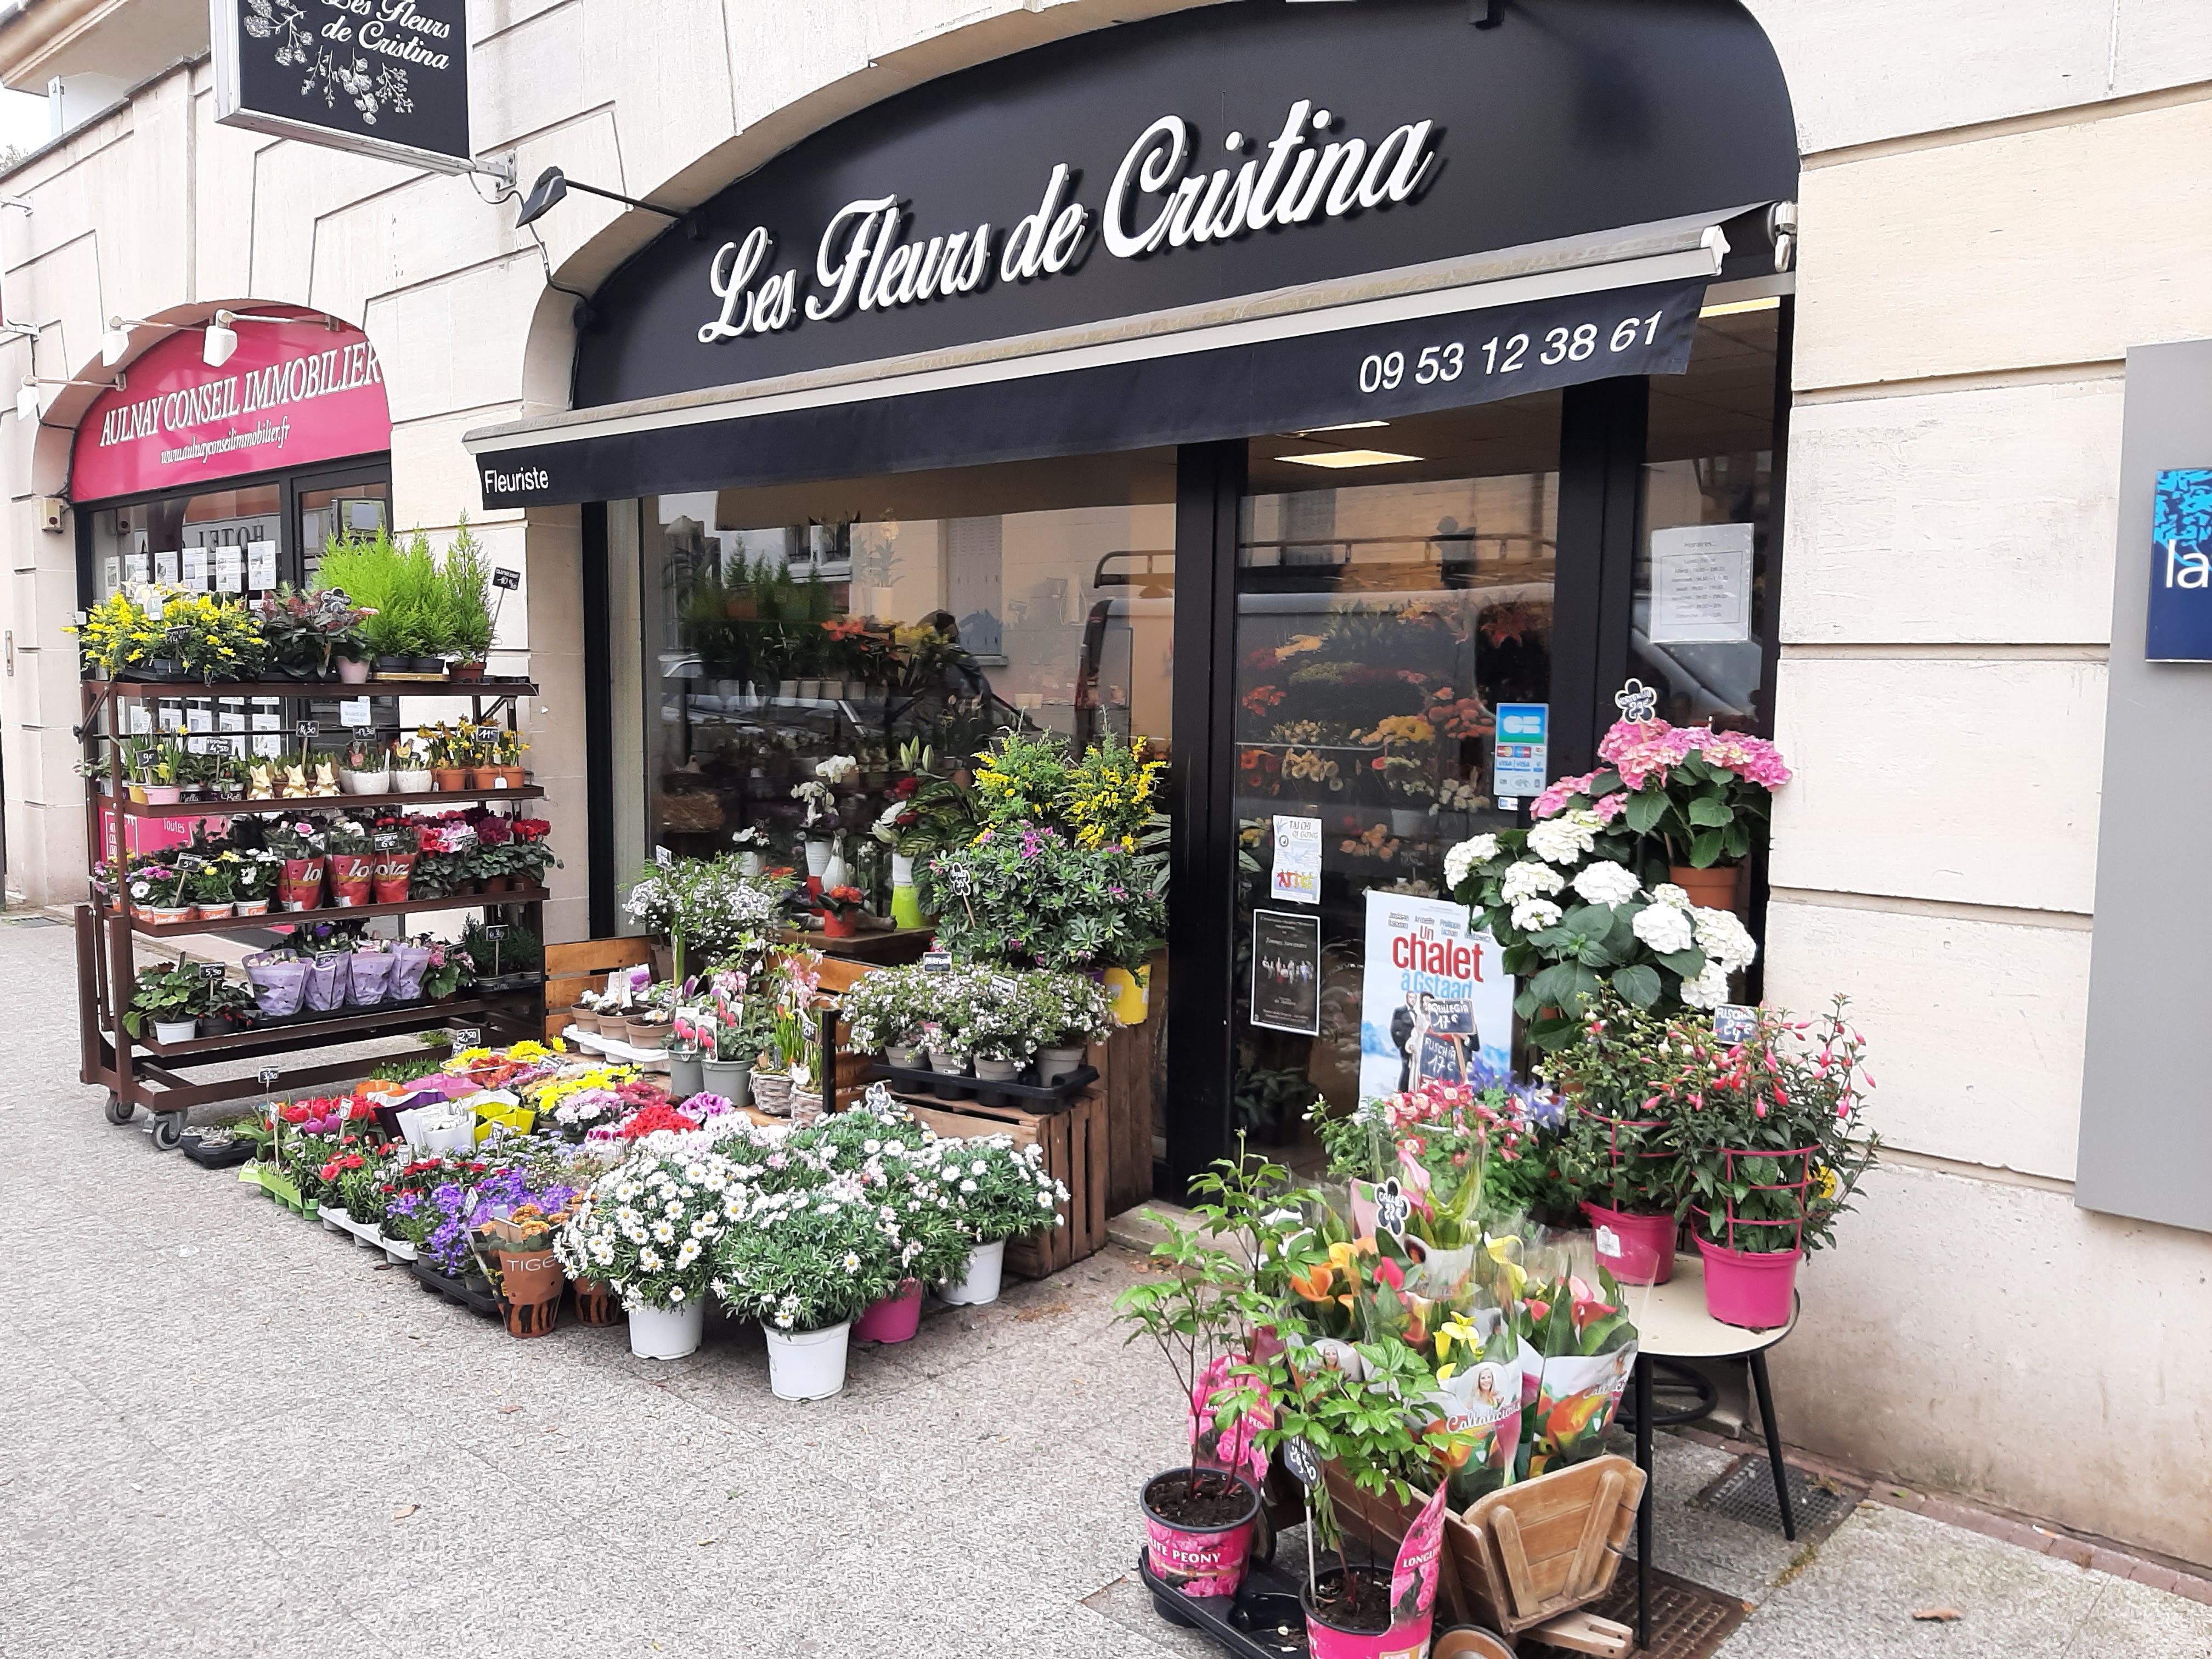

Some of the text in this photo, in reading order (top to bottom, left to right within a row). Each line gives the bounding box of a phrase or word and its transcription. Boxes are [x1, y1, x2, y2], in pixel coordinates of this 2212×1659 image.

[322, 0, 450, 38] es Fleurs
[321, 15, 449, 69] de Cristina
[698, 99, 1434, 343] Les Fleurs de Cristina
[1359, 310, 1663, 393] 09 53 12 38 61
[99, 341, 381, 447] AULNAY CONSEIL IMMOBILIER
[484, 467, 549, 493] Fleuriste
[1392, 932, 1485, 983] chalet
[1413, 971, 1473, 1000] Gstaad
[506, 1255, 555, 1272] TIGE
[1447, 1402, 1521, 1432] Callalicious
[1172, 1549, 1221, 1565] PEONY
